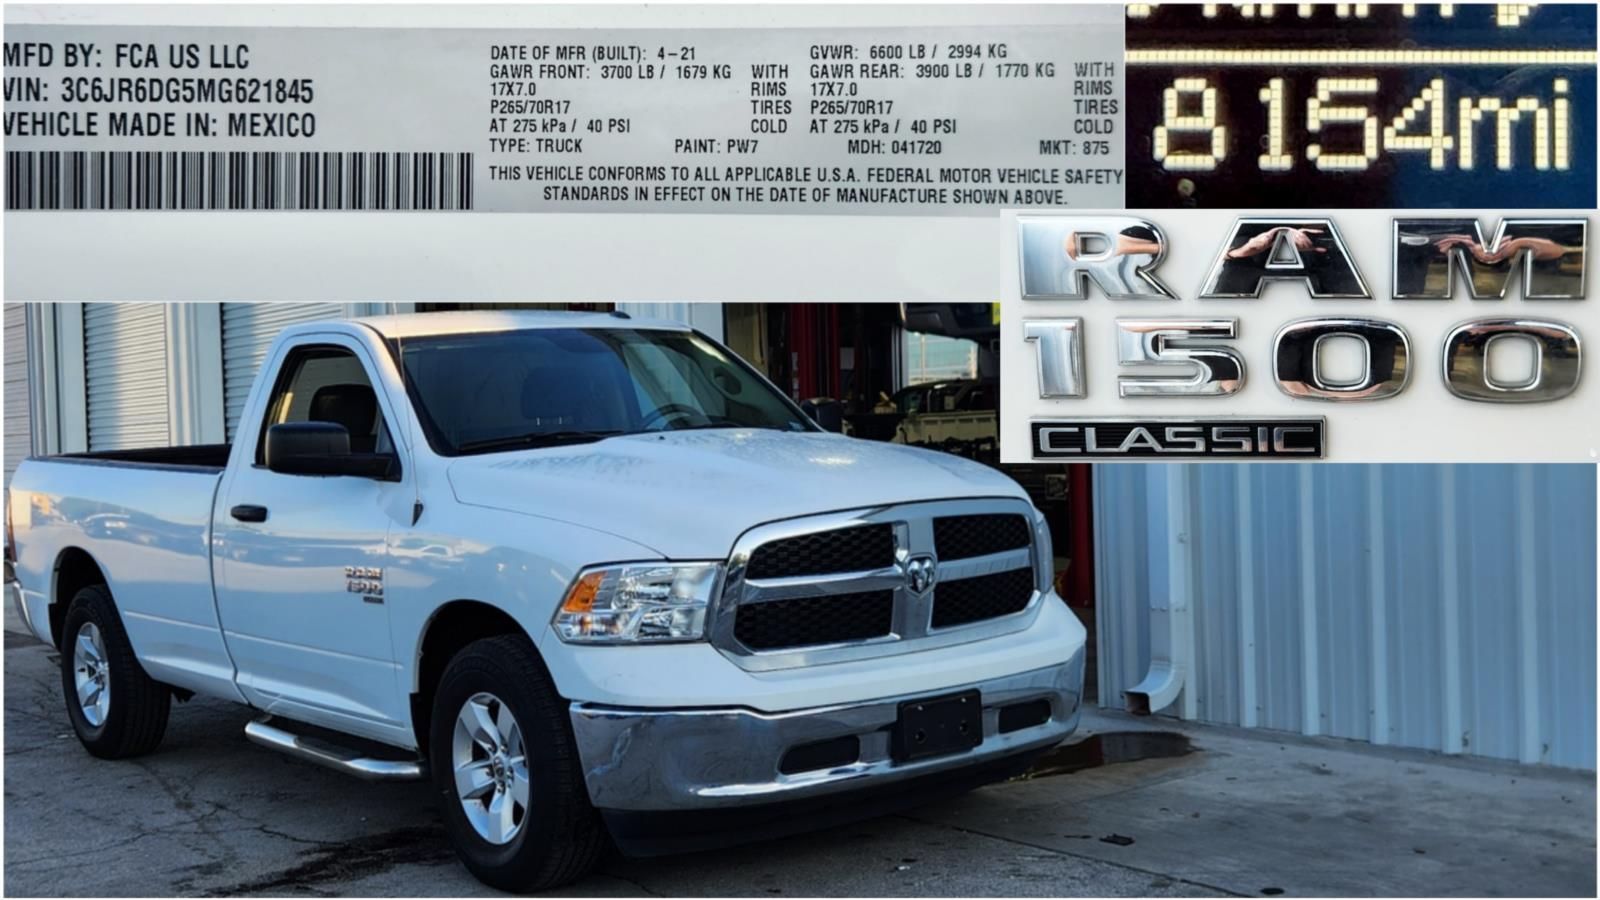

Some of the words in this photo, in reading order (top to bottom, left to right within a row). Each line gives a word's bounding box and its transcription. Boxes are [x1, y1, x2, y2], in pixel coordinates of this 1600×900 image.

[4, 43, 53, 67] MFD
[65, 43, 101, 67] BY:
[116, 43, 158, 68] FCA
[170, 44, 199, 69] US
[210, 44, 248, 69] LLC
[491, 46, 526, 60] DATE
[533, 46, 549, 60] OF
[556, 46, 585, 60] MFR
[593, 46, 645, 63] (BUILT):
[810, 45, 857, 59] GVWR:
[870, 45, 902, 59] 6600
[909, 44, 925, 59] LB
[949, 45, 981, 58] 2994
[988, 44, 1007, 58] KG
[490, 64, 532, 78] GAWR
[540, 64, 589, 79] FRONT:
[601, 65, 632, 79] 3700
[639, 65, 654, 79] LB
[677, 65, 707, 79] 1679
[713, 65, 731, 79] KG
[752, 64, 788, 79] WITH
[810, 64, 853, 78] GAWR
[860, 64, 903, 78] REAR:
[916, 64, 949, 78] 3900
[956, 63, 972, 78] LB
[996, 63, 1029, 77] 1770
[1036, 63, 1054, 77] KG
[1075, 62, 1114, 77] WITH
[62, 77, 313, 103] 3C6JR6DG5MG621845
[491, 82, 536, 96] 17X7.0
[751, 82, 786, 96] RIMS
[811, 82, 857, 96] 17X7.0
[1074, 80, 1112, 95] RIMS
[491, 99, 570, 114] P265/70R17
[751, 100, 791, 114] TIRES
[811, 100, 893, 114] P265/70R17
[1074, 99, 1118, 114] TIRES
[109, 112, 175, 136] MADE
[187, 113, 216, 136] IN:
[229, 113, 315, 137] MEXICO
[490, 118, 507, 132] AT
[513, 119, 537, 132] 275
[542, 118, 566, 132] kPa
[587, 119, 602, 132] 40
[609, 119, 629, 133] PSI
[751, 119, 787, 133] COLD
[810, 119, 828, 133] AT
[834, 120, 859, 133] 275
[864, 119, 889, 133] kPa
[911, 120, 927, 133] 40
[934, 119, 956, 134] PSI
[1074, 119, 1113, 134] COLD
[489, 138, 529, 152] TYPE:
[536, 138, 582, 152] TRUCK
[675, 139, 720, 153] PAINT:
[728, 139, 758, 153] PW7
[848, 139, 885, 154] MDH:
[892, 140, 941, 154] 041720
[1040, 140, 1075, 154] MKT:
[1083, 141, 1109, 155] 875
[489, 166, 520, 180] THIS
[526, 166, 583, 180] VEHICLE
[589, 166, 665, 181] CONFORMS
[671, 167, 689, 181] TO
[694, 167, 720, 181] ALL
[725, 167, 811, 182] APPLICABLE
[818, 168, 860, 182] U.S.A.
[868, 168, 933, 182] FEDERAL
[940, 168, 991, 183] MOTOR
[998, 169, 1059, 183] VEHICLE
[1065, 169, 1123, 183] SAFETY
[544, 186, 628, 200] STANDARDS
[635, 187, 648, 200] IN
[655, 187, 705, 201] EFFECT
[712, 187, 730, 201] ON
[736, 187, 763, 202] THE
[770, 187, 806, 202] DATE
[812, 188, 830, 202] OF
[837, 188, 946, 203] MANUFACTURE
[953, 189, 1008, 204] SHOWN
[1014, 188, 1068, 204] ABOVE.
[1016, 213, 1589, 301] RAM
[1022, 315, 1585, 403] 1500
[1038, 425, 1318, 453] CLASSIC
